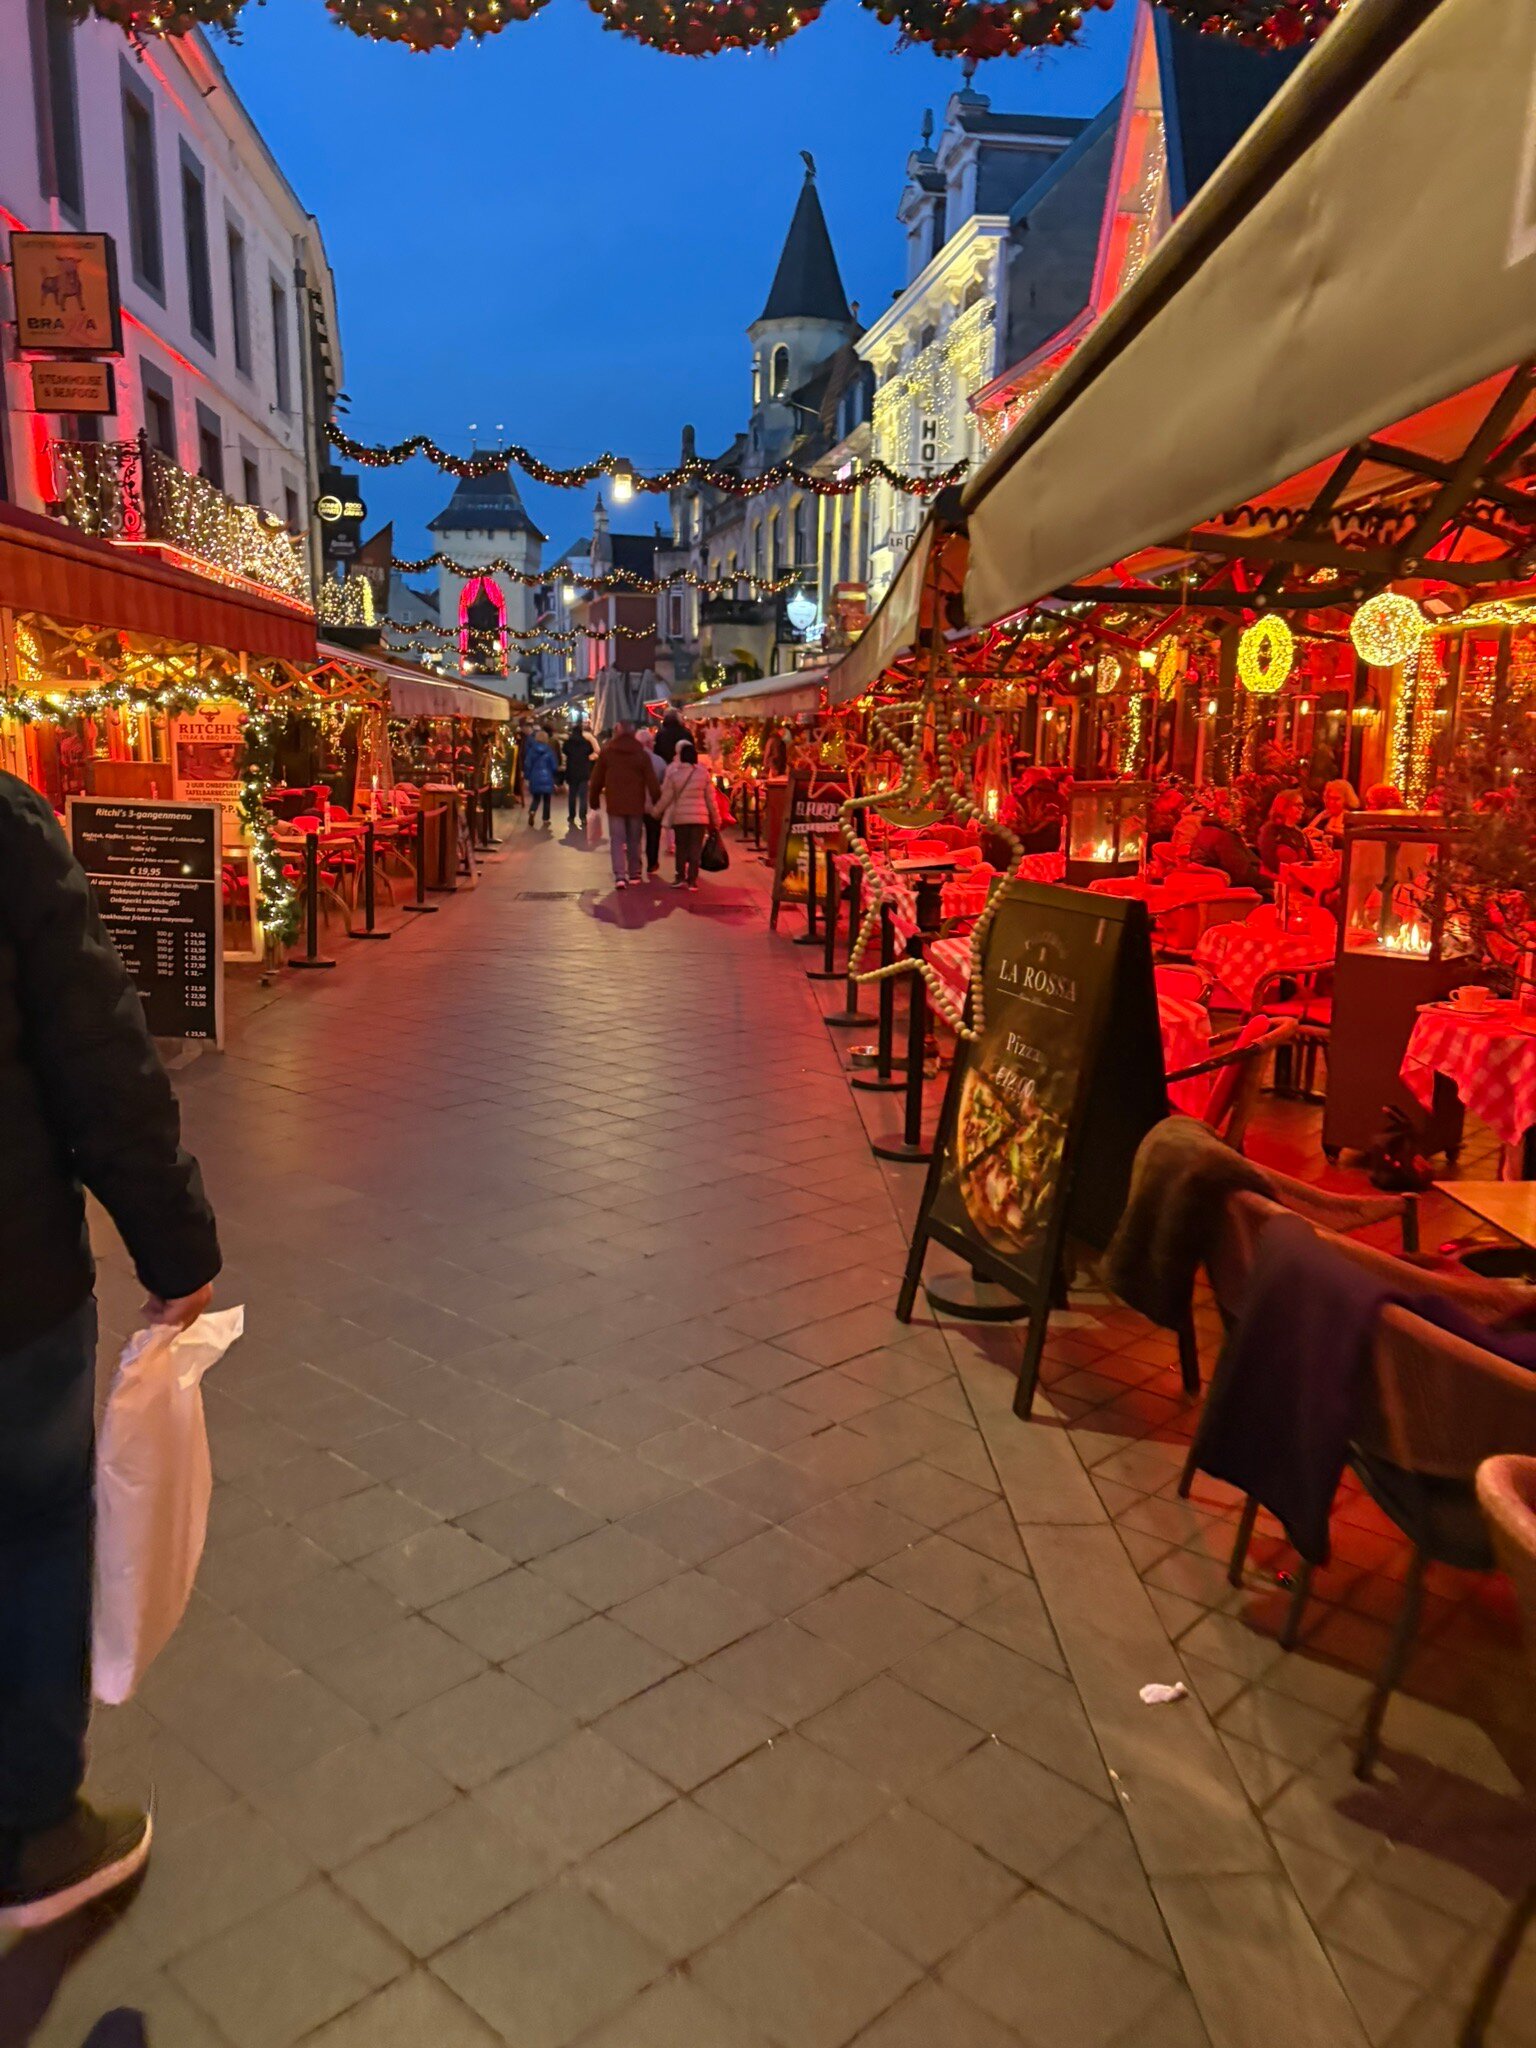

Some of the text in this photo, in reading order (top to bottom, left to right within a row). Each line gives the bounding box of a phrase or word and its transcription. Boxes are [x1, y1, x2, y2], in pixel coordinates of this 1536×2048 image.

[38, 374, 103, 386] STEAKHOUSE
[54, 387, 99, 399] SEAFOOD
[95, 807, 193, 821] Ritchi's 3-gangenmenu
[129, 866, 161, 876] € 19,95
[999, 959, 1018, 984] LA
[1023, 966, 1076, 1002] ROSSA
[1006, 1032, 1040, 1062] Pizza
